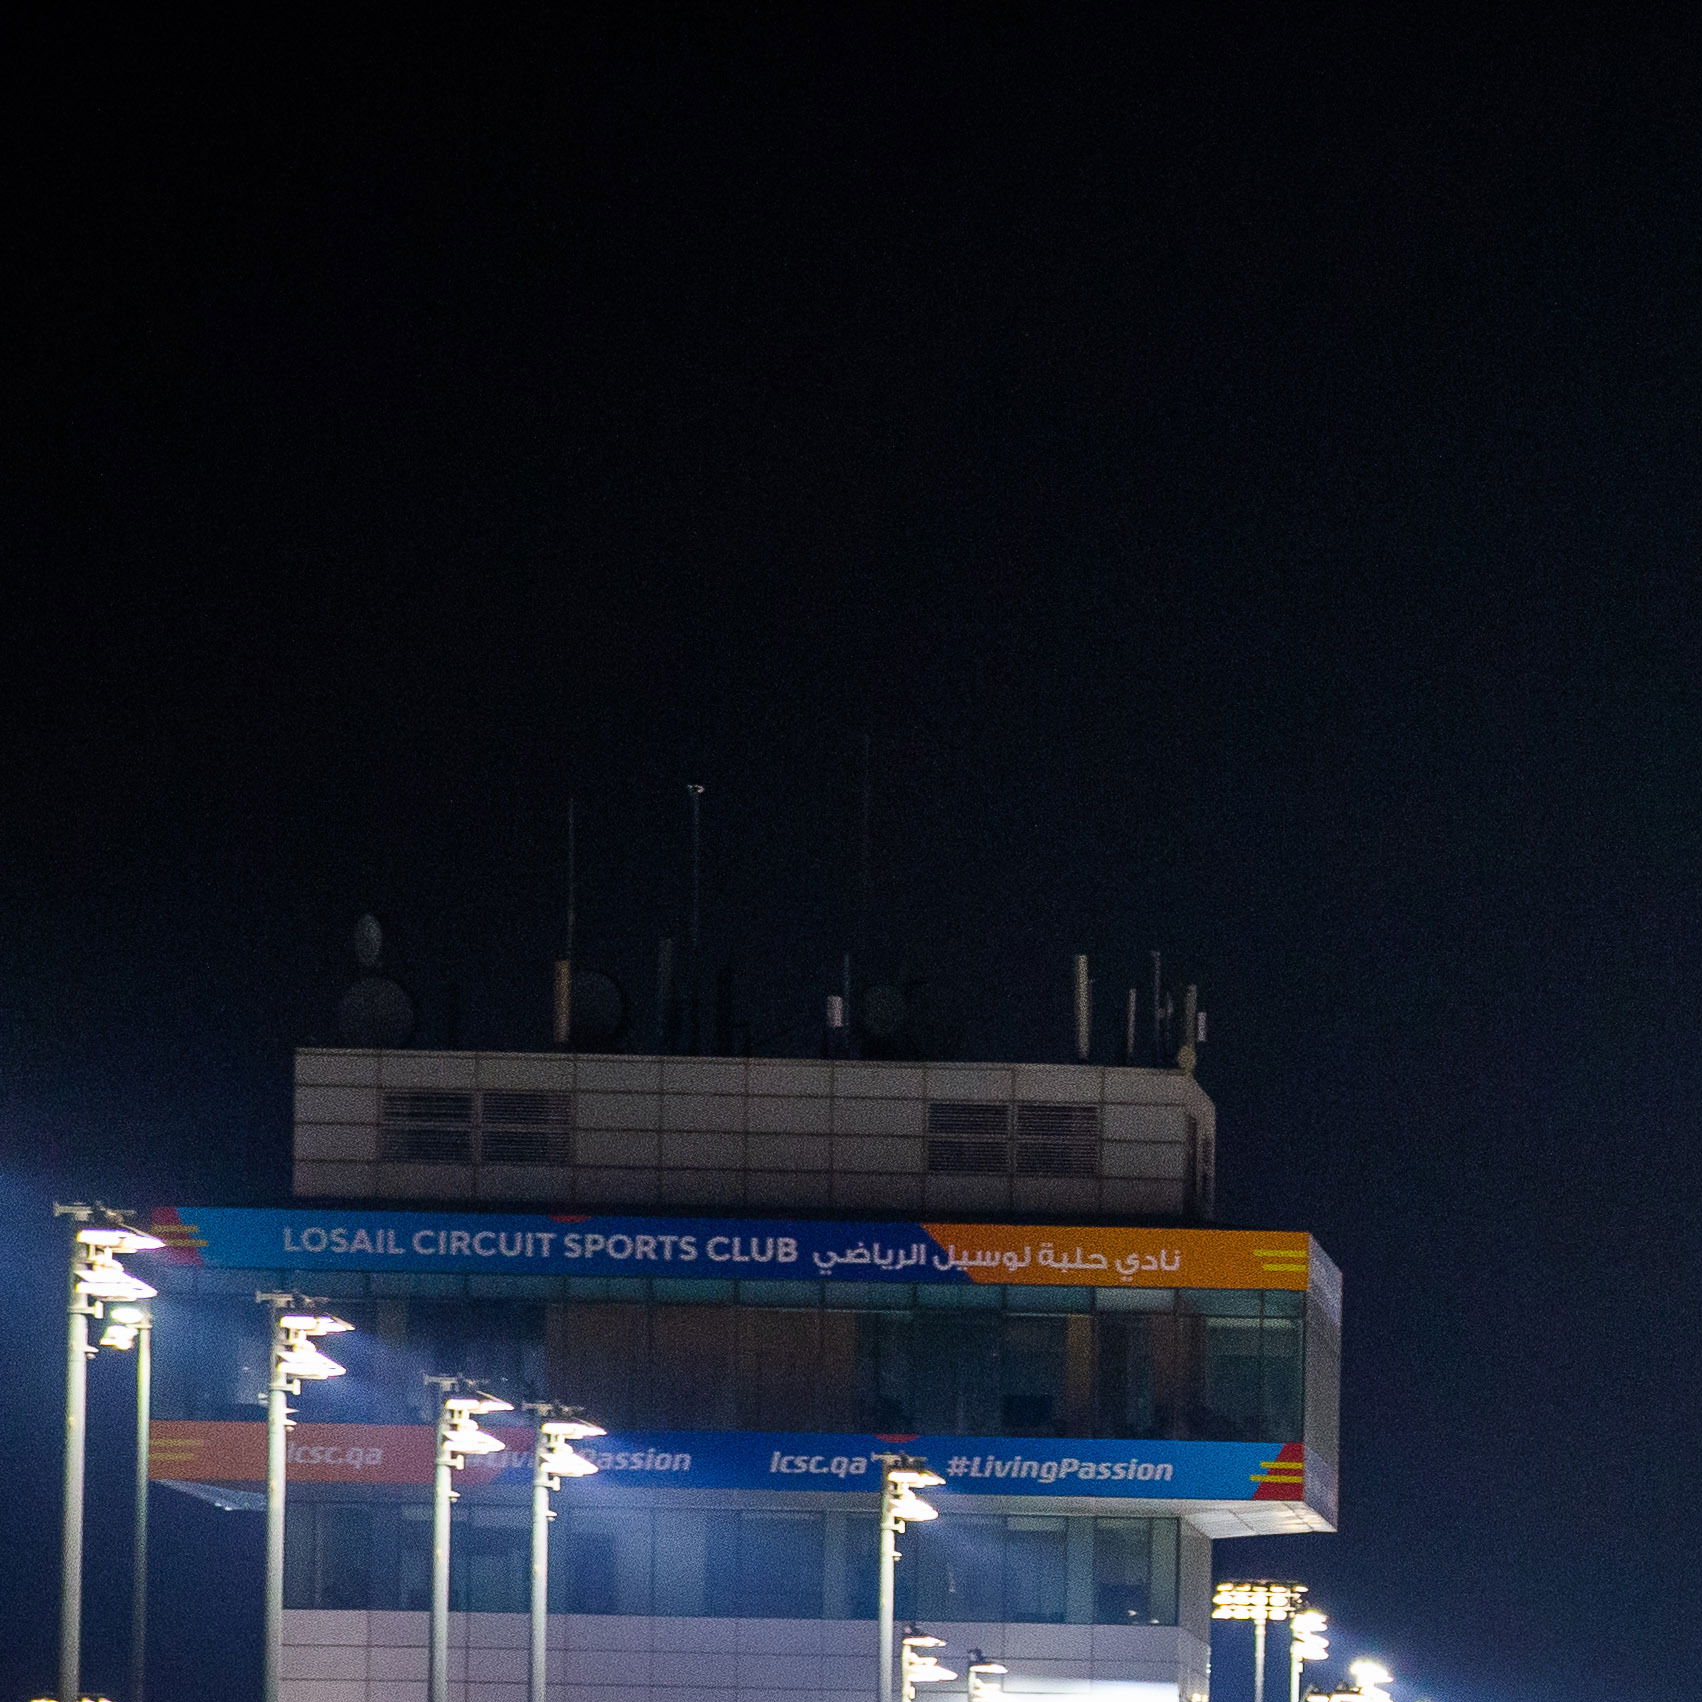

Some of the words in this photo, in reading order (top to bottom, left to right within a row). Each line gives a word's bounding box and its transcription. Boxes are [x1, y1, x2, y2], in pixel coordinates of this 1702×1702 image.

[283, 1226, 406, 1255] LOSAIL
[412, 1229, 557, 1258] CIRCUIT
[563, 1232, 698, 1262] SPORTS
[706, 1236, 799, 1263] CLUB
[812, 1241, 927, 1276] الرياضي
[932, 1244, 1033, 1273] لوسيل
[1037, 1242, 1109, 1273] حلبة
[1114, 1247, 1182, 1282] نادي
[946, 1455, 1174, 1484] #LivingPassion
